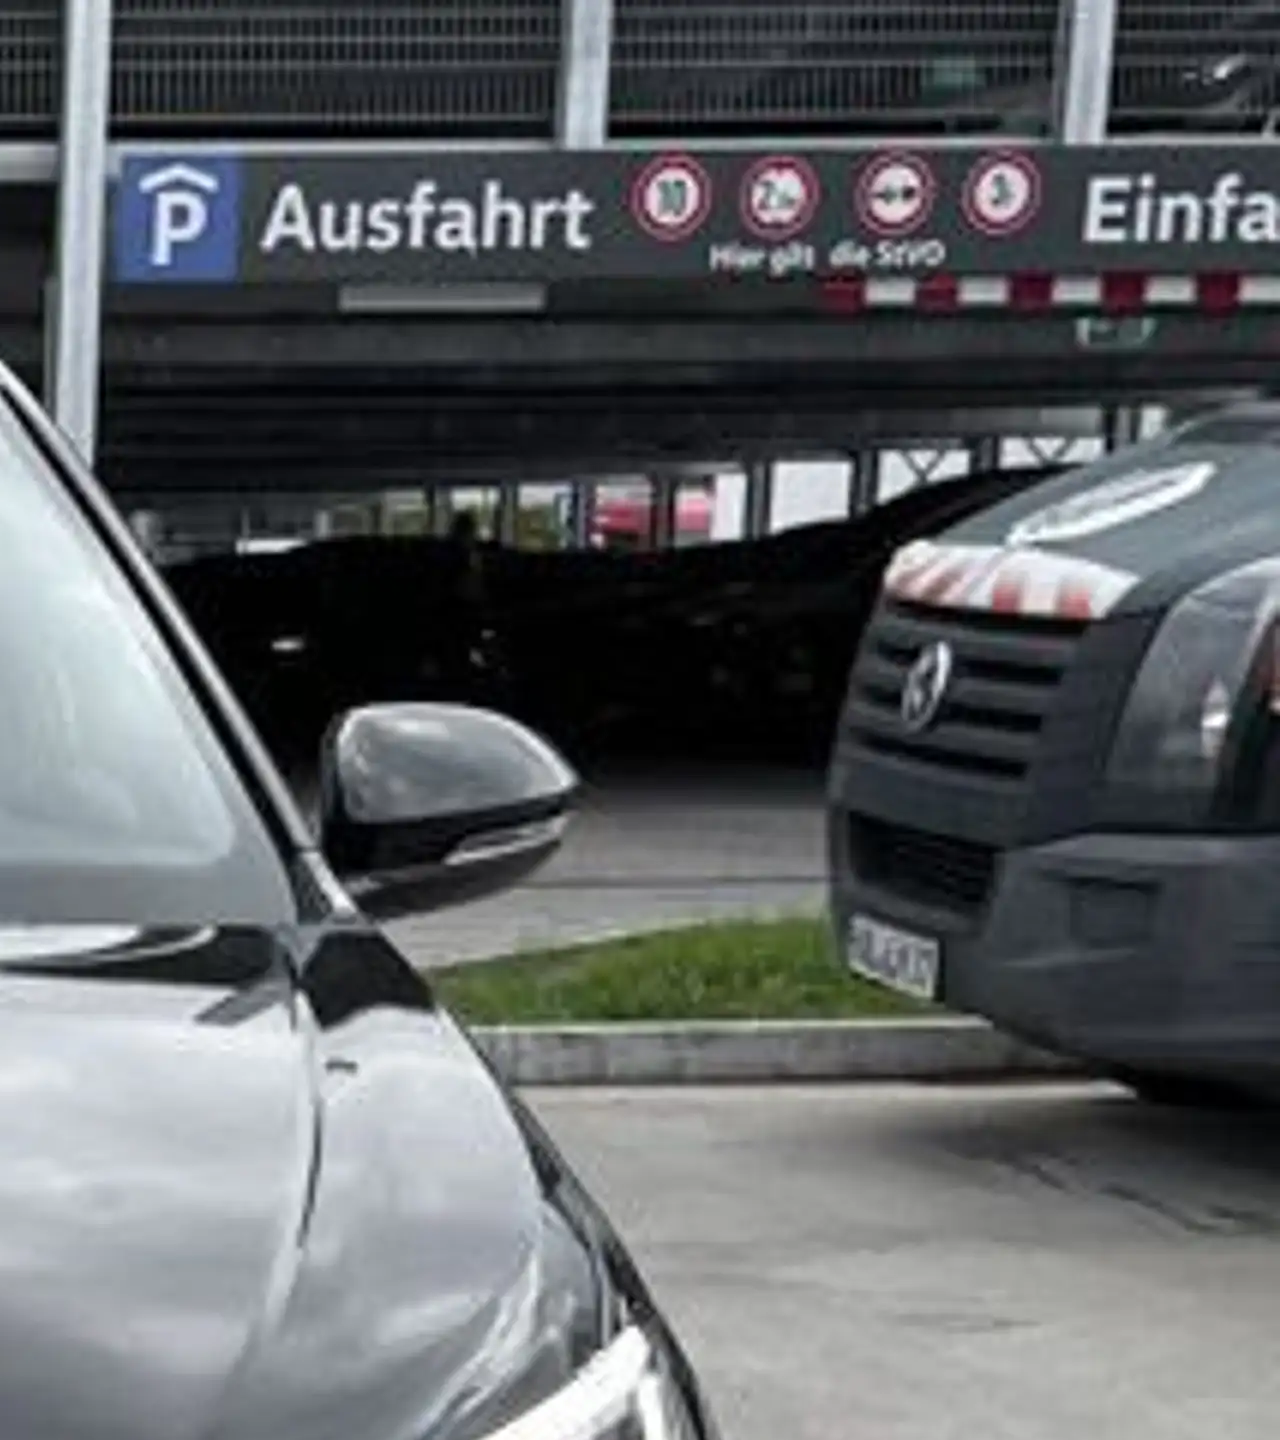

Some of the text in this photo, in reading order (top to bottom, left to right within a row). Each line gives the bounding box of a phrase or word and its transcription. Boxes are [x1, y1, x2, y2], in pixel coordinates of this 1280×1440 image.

[151, 191, 208, 266] P
[259, 180, 594, 253] Ausfahrt
[1083, 172, 1280, 243] Einfa
